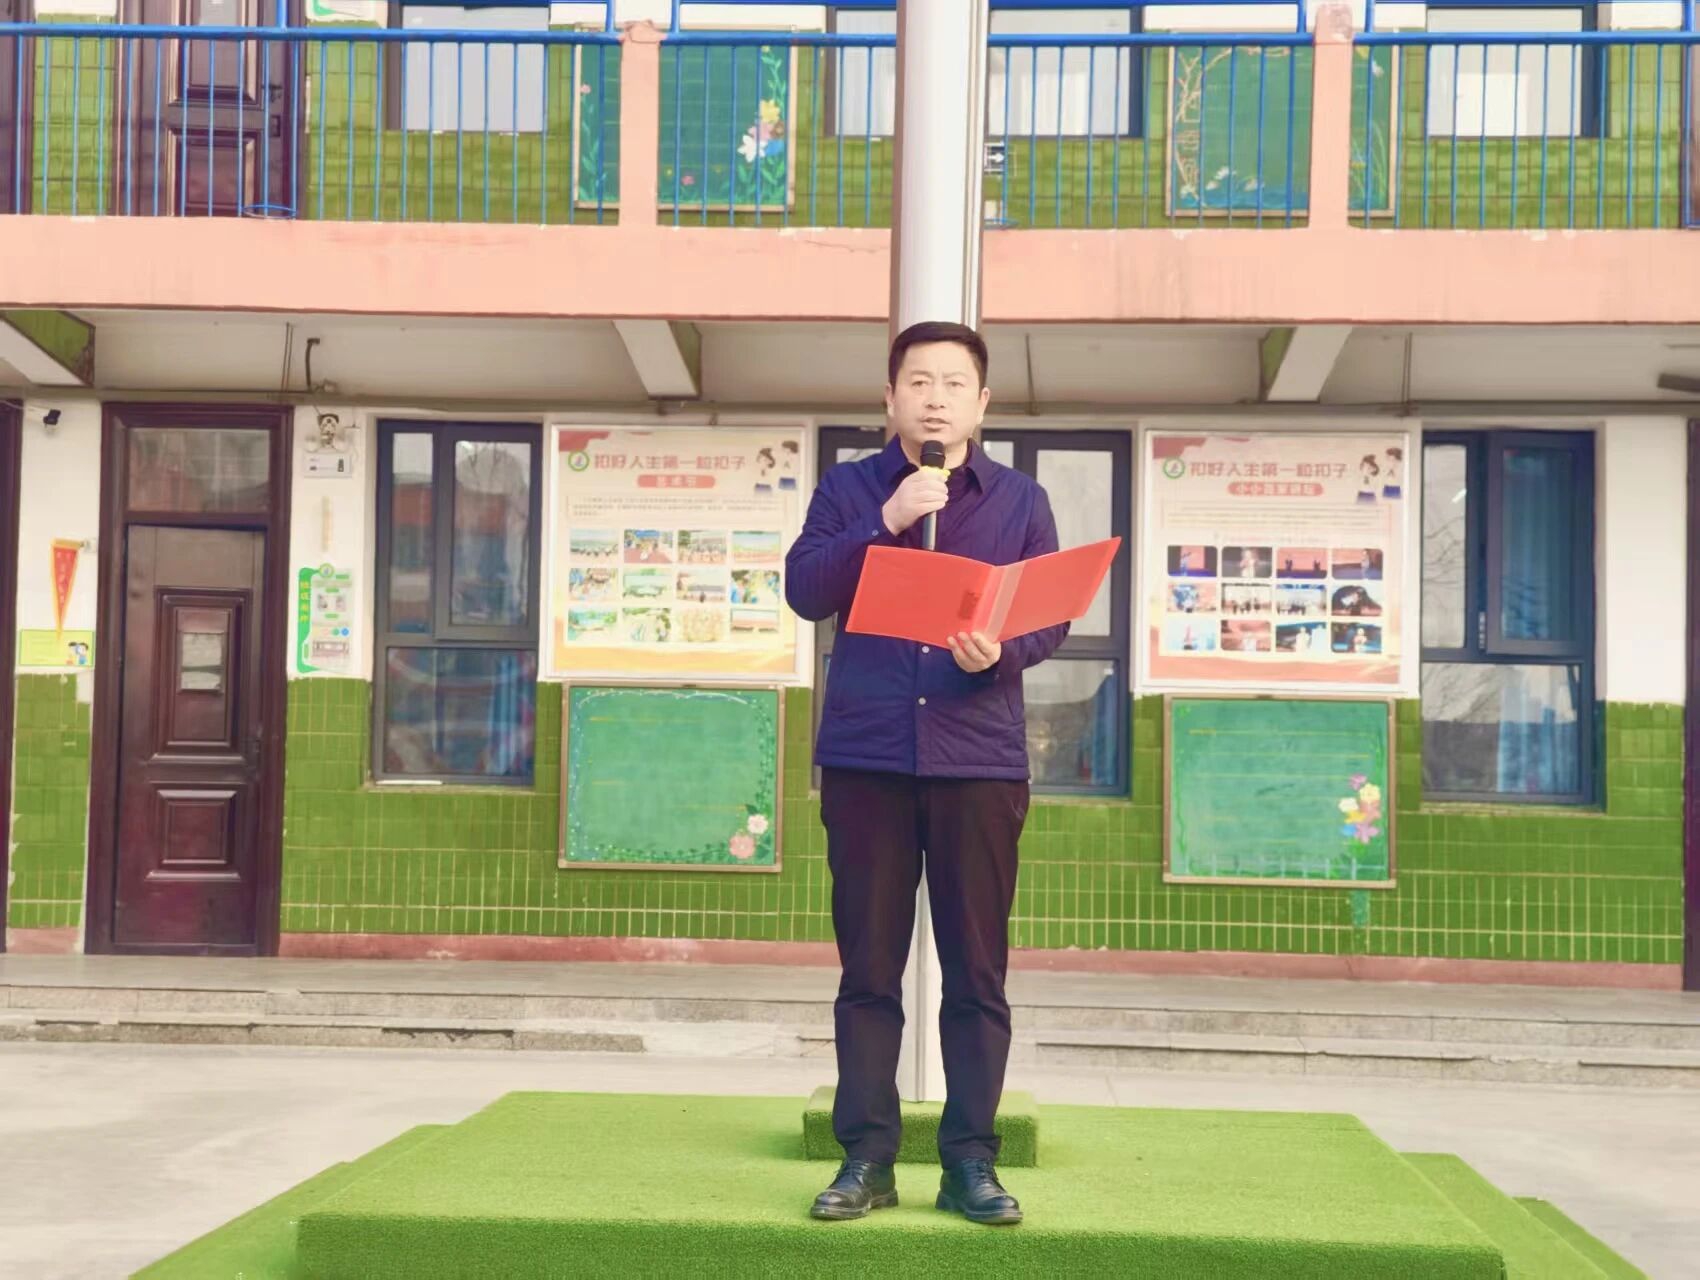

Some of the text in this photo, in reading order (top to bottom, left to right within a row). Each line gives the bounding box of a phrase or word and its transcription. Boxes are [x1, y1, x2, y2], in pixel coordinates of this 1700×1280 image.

[594, 454, 746, 470] 扣好人生第一粒扣子
[1190, 462, 1349, 478] 扣好人生第一粒扣子
